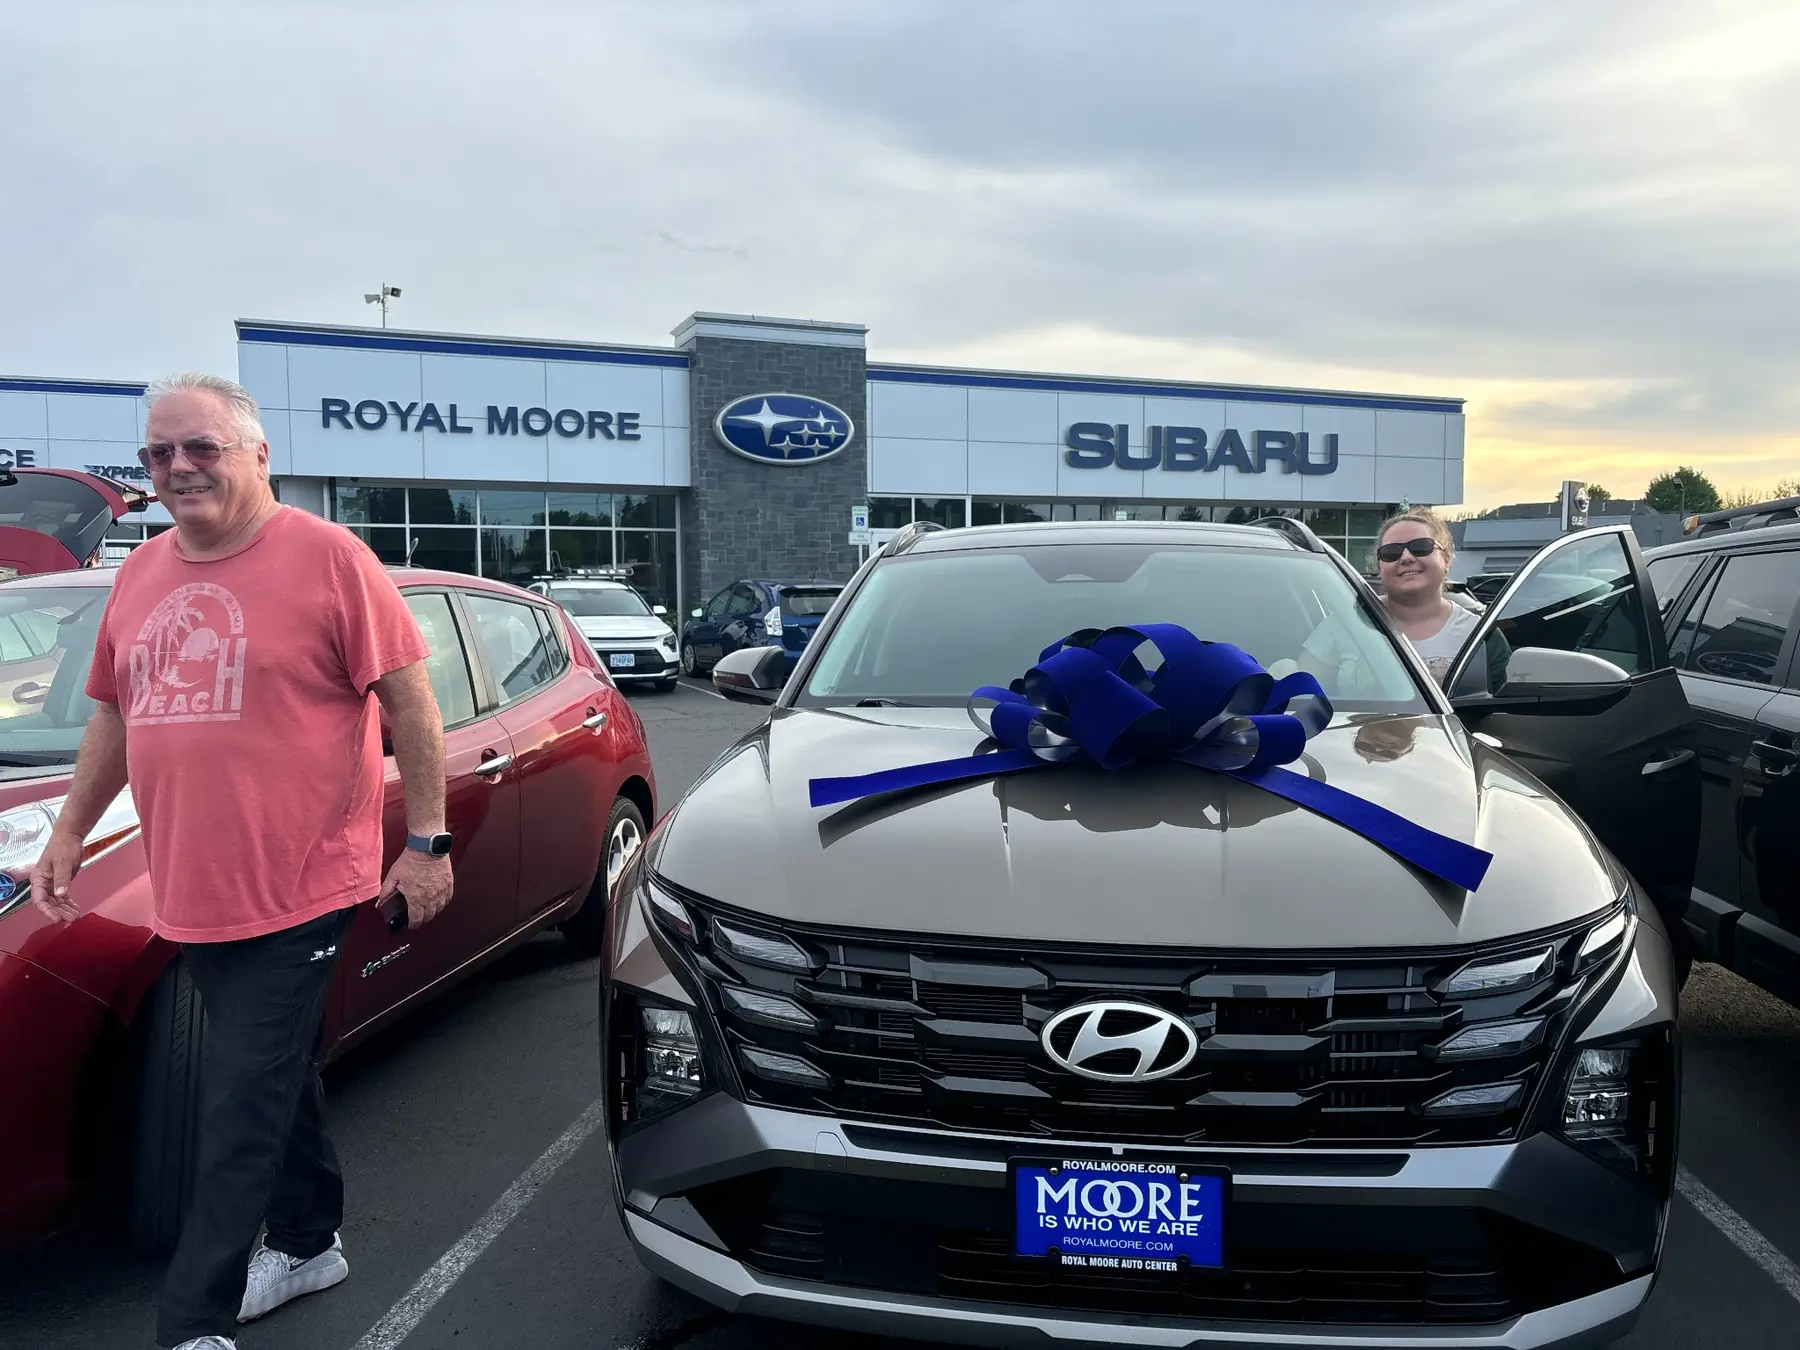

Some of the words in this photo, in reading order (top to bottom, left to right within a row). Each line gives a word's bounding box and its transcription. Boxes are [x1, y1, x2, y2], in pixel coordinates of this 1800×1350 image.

[321, 398, 473, 434] ROYAL
[487, 405, 642, 441] MOORE
[1066, 422, 1339, 476] SUBARU
[129, 637, 248, 717] BEACH
[1062, 1160, 1176, 1175] ROYALMOORE.COM
[1034, 1176, 1203, 1222] MOORE
[1039, 1215, 1058, 1229] IS
[1064, 1216, 1113, 1231] WHO
[1119, 1219, 1151, 1234] WE
[1156, 1222, 1199, 1237] ARE
[1063, 1236, 1174, 1252] ROYALMOORE.COM
[1061, 1255, 1088, 1267] ROYAL
[1089, 1256, 1120, 1268] MOORE
[1121, 1258, 1143, 1270] AUTO
[1145, 1259, 1178, 1272] CENTER
